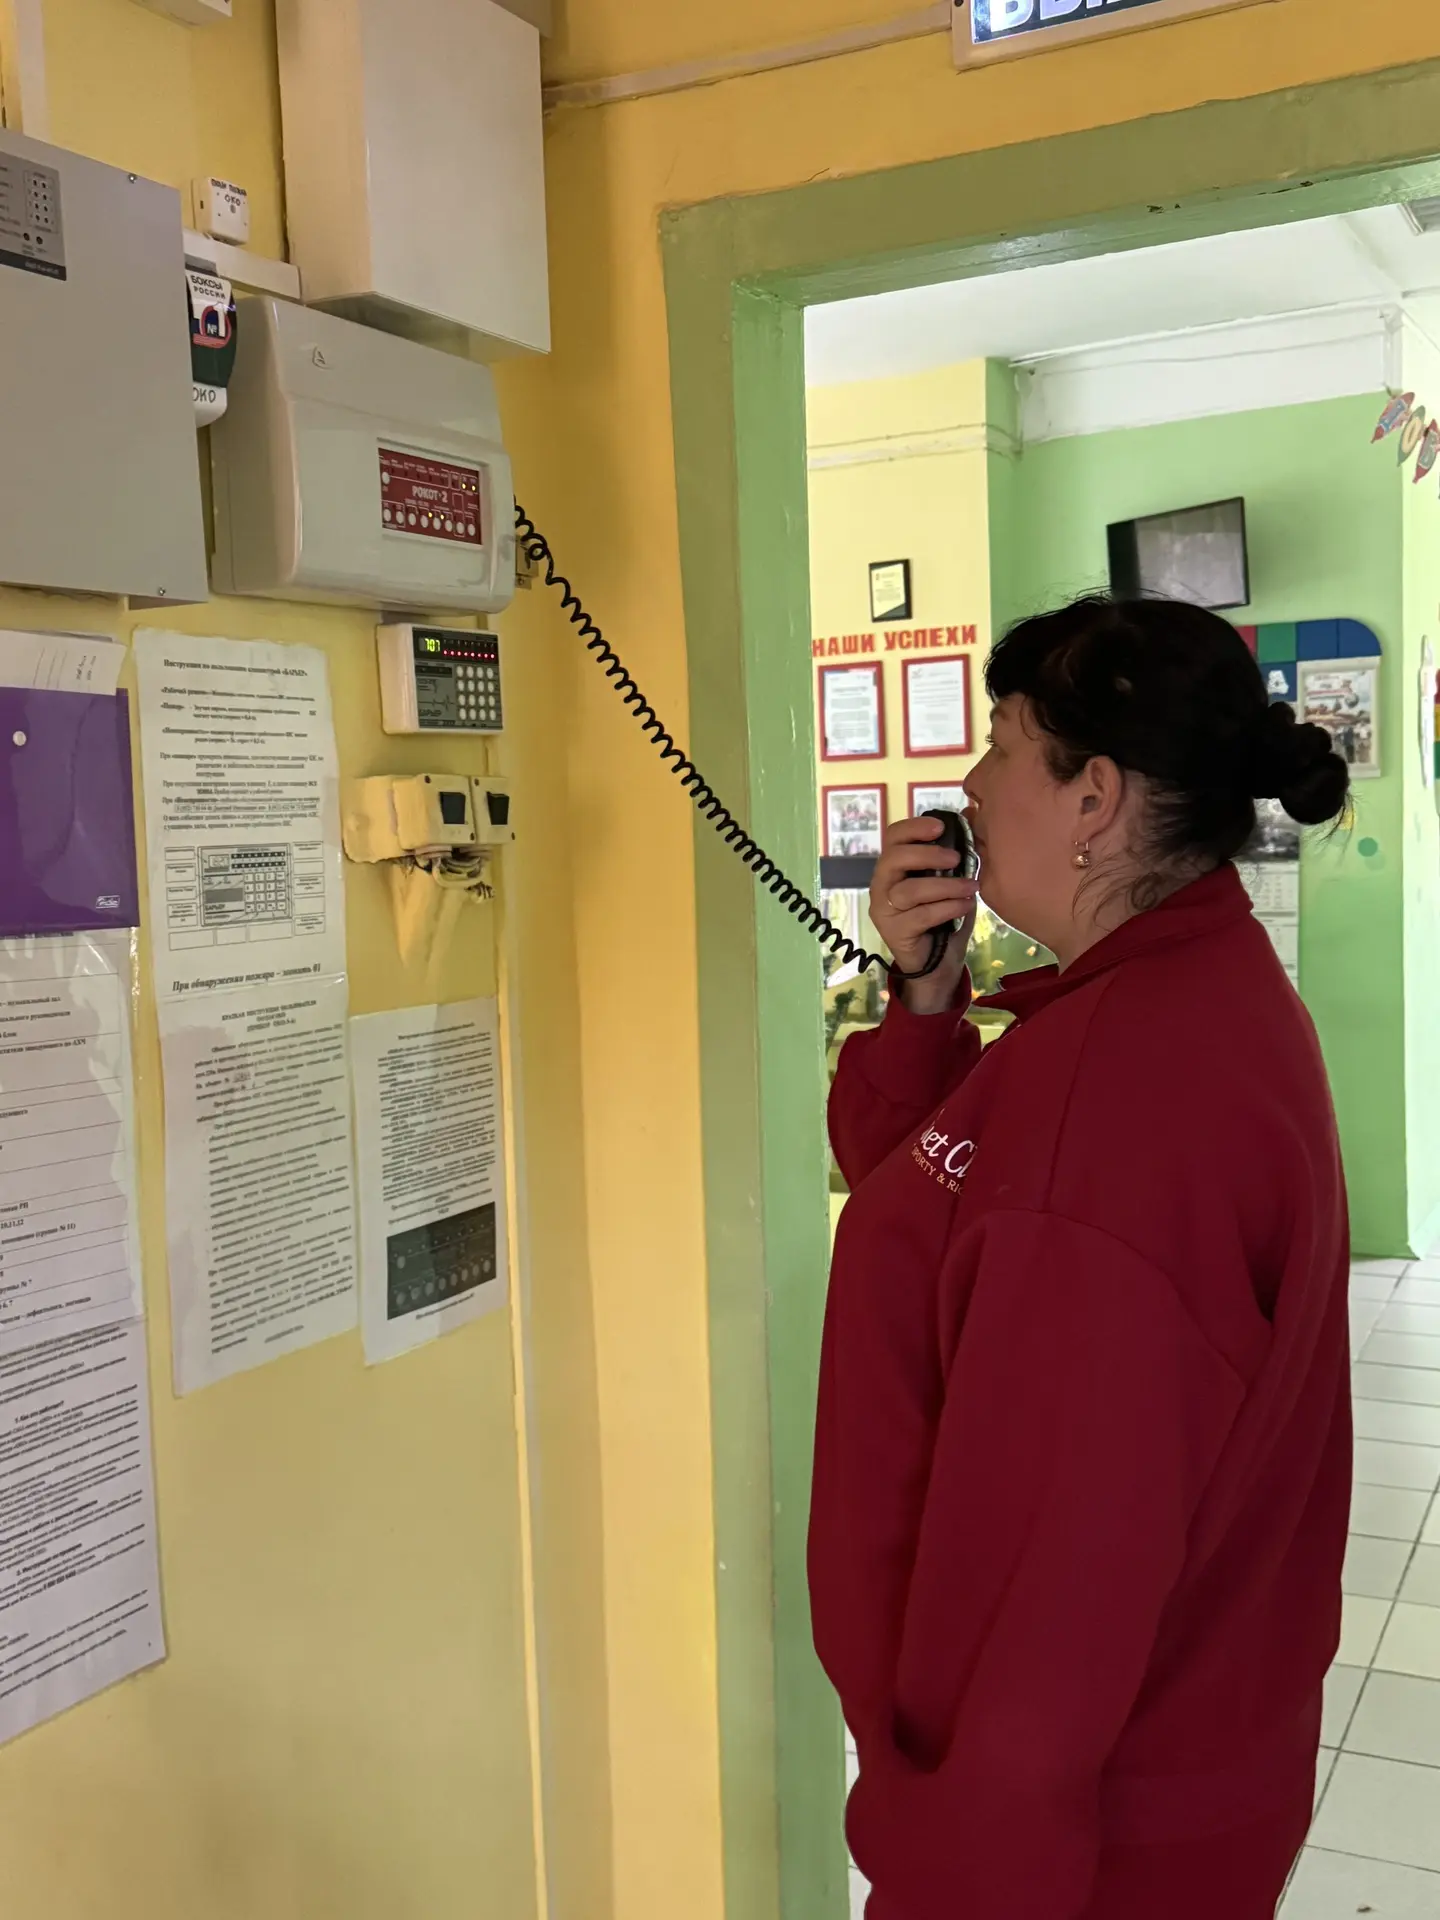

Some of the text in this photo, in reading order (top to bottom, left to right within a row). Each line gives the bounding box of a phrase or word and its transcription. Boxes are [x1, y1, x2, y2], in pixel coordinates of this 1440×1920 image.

[224, 194, 241, 207] ОКО
[190, 274, 224, 291] БОКСЫ
[193, 285, 226, 300] РОССИИ
[812, 624, 978, 658] НАШИ УСПЕХИ
[172, 980, 190, 993] При
[936, 1172, 946, 1185] &
